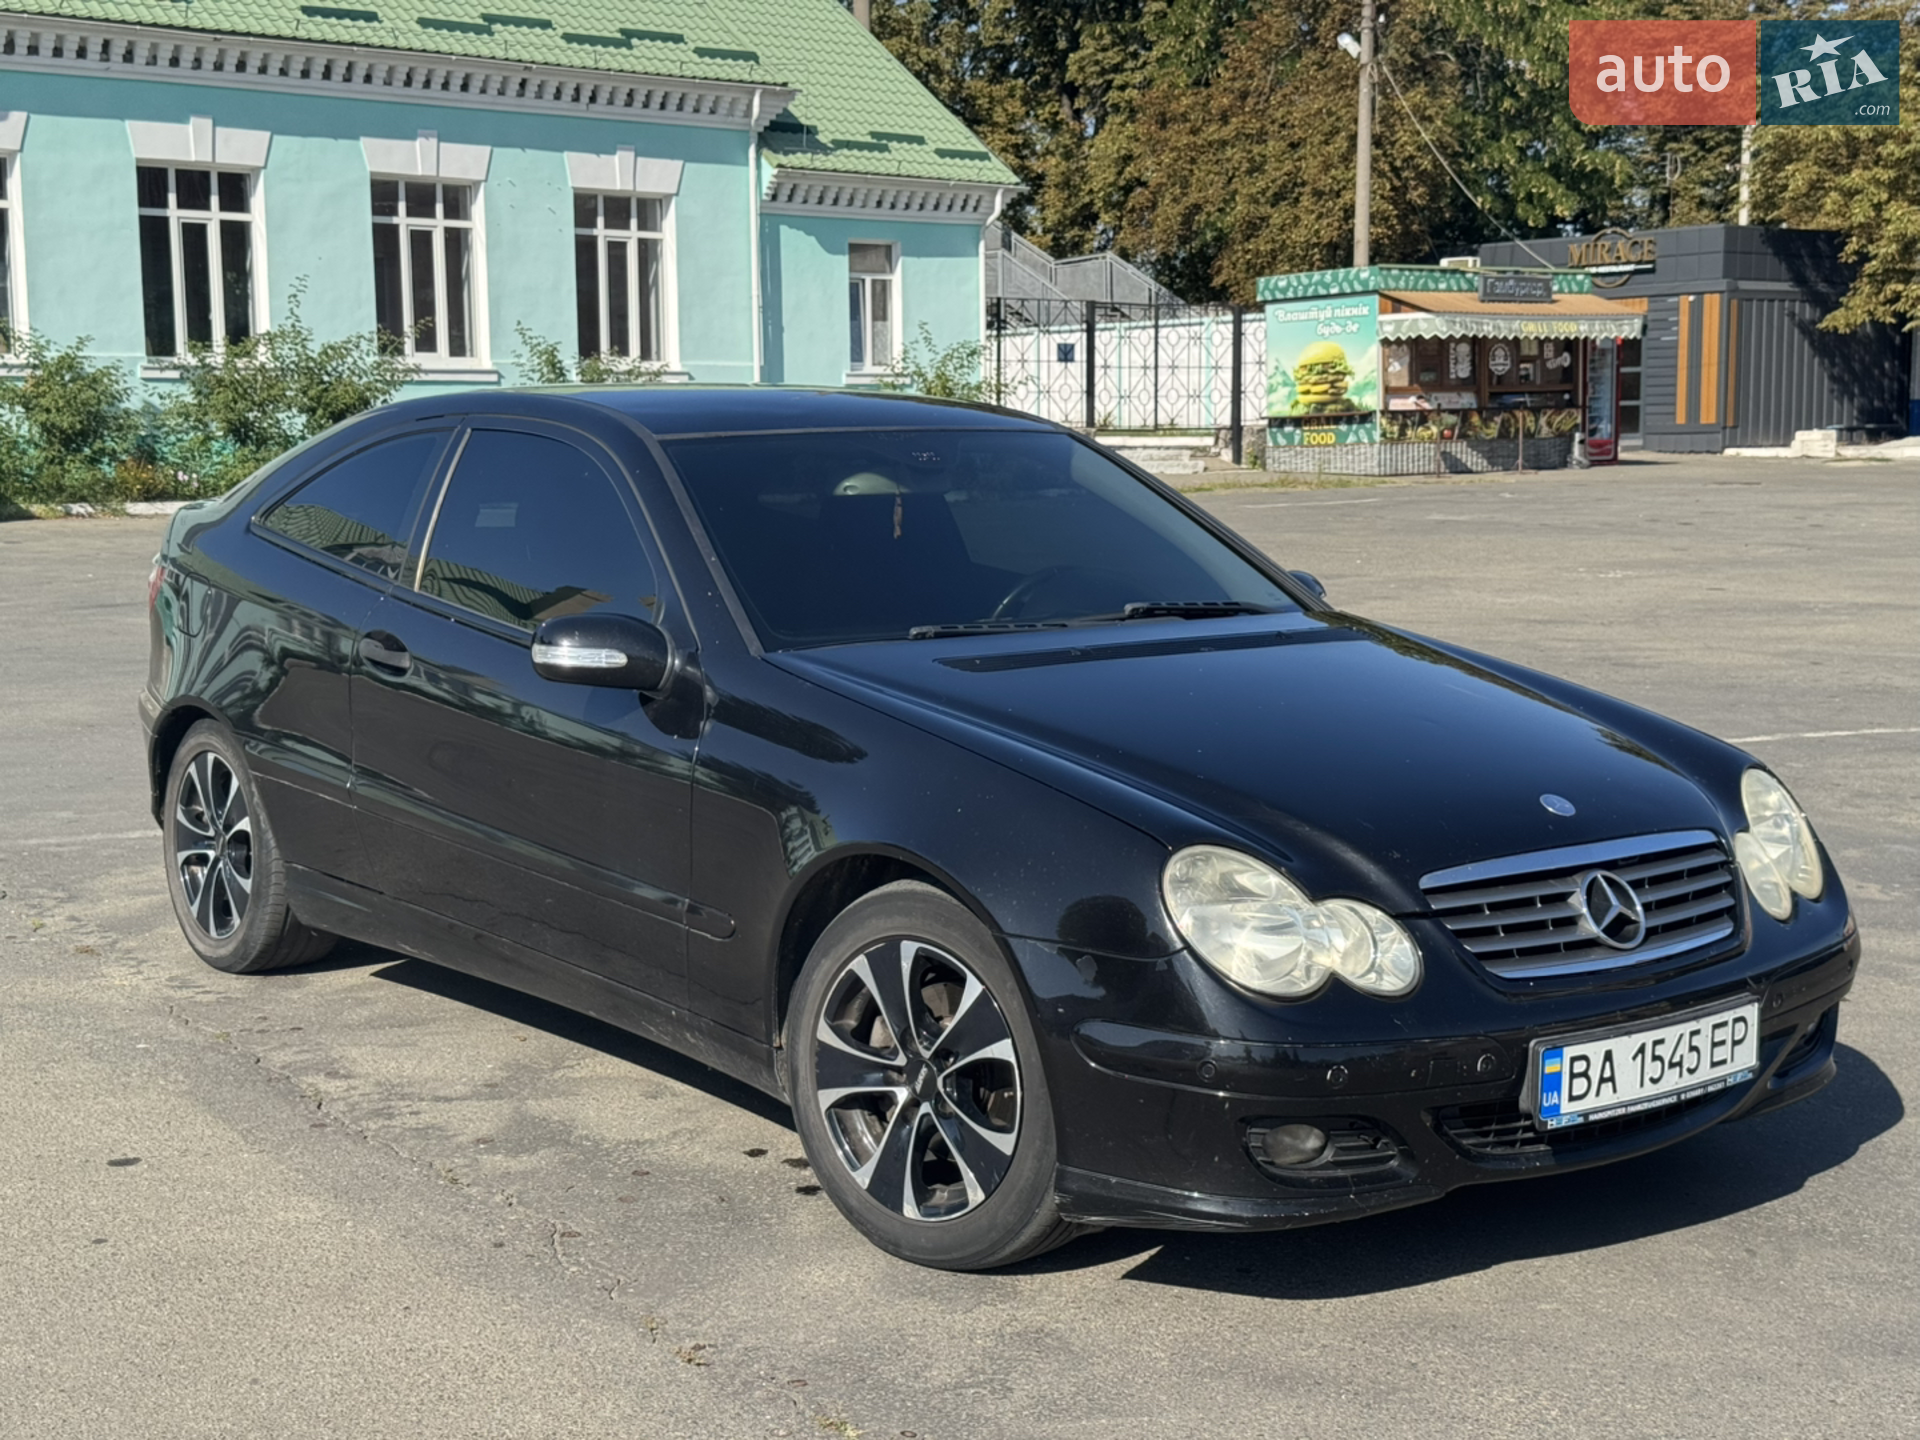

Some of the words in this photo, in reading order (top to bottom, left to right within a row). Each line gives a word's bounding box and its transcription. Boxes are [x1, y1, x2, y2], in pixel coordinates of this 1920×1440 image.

[1567, 236, 1656, 267] MIRAGE
[1275, 305, 1332, 322] Влаштуй
[1334, 302, 1370, 318] пікнік
[1317, 320, 1360, 338] будь-де
[1552, 321, 1578, 333] FOOD
[1303, 431, 1336, 446] FOOD
[1567, 1048, 1618, 1103] BA
[1631, 1028, 1702, 1089] 1545
[1708, 1015, 1749, 1071] EP
[1543, 1090, 1560, 1107] UA
